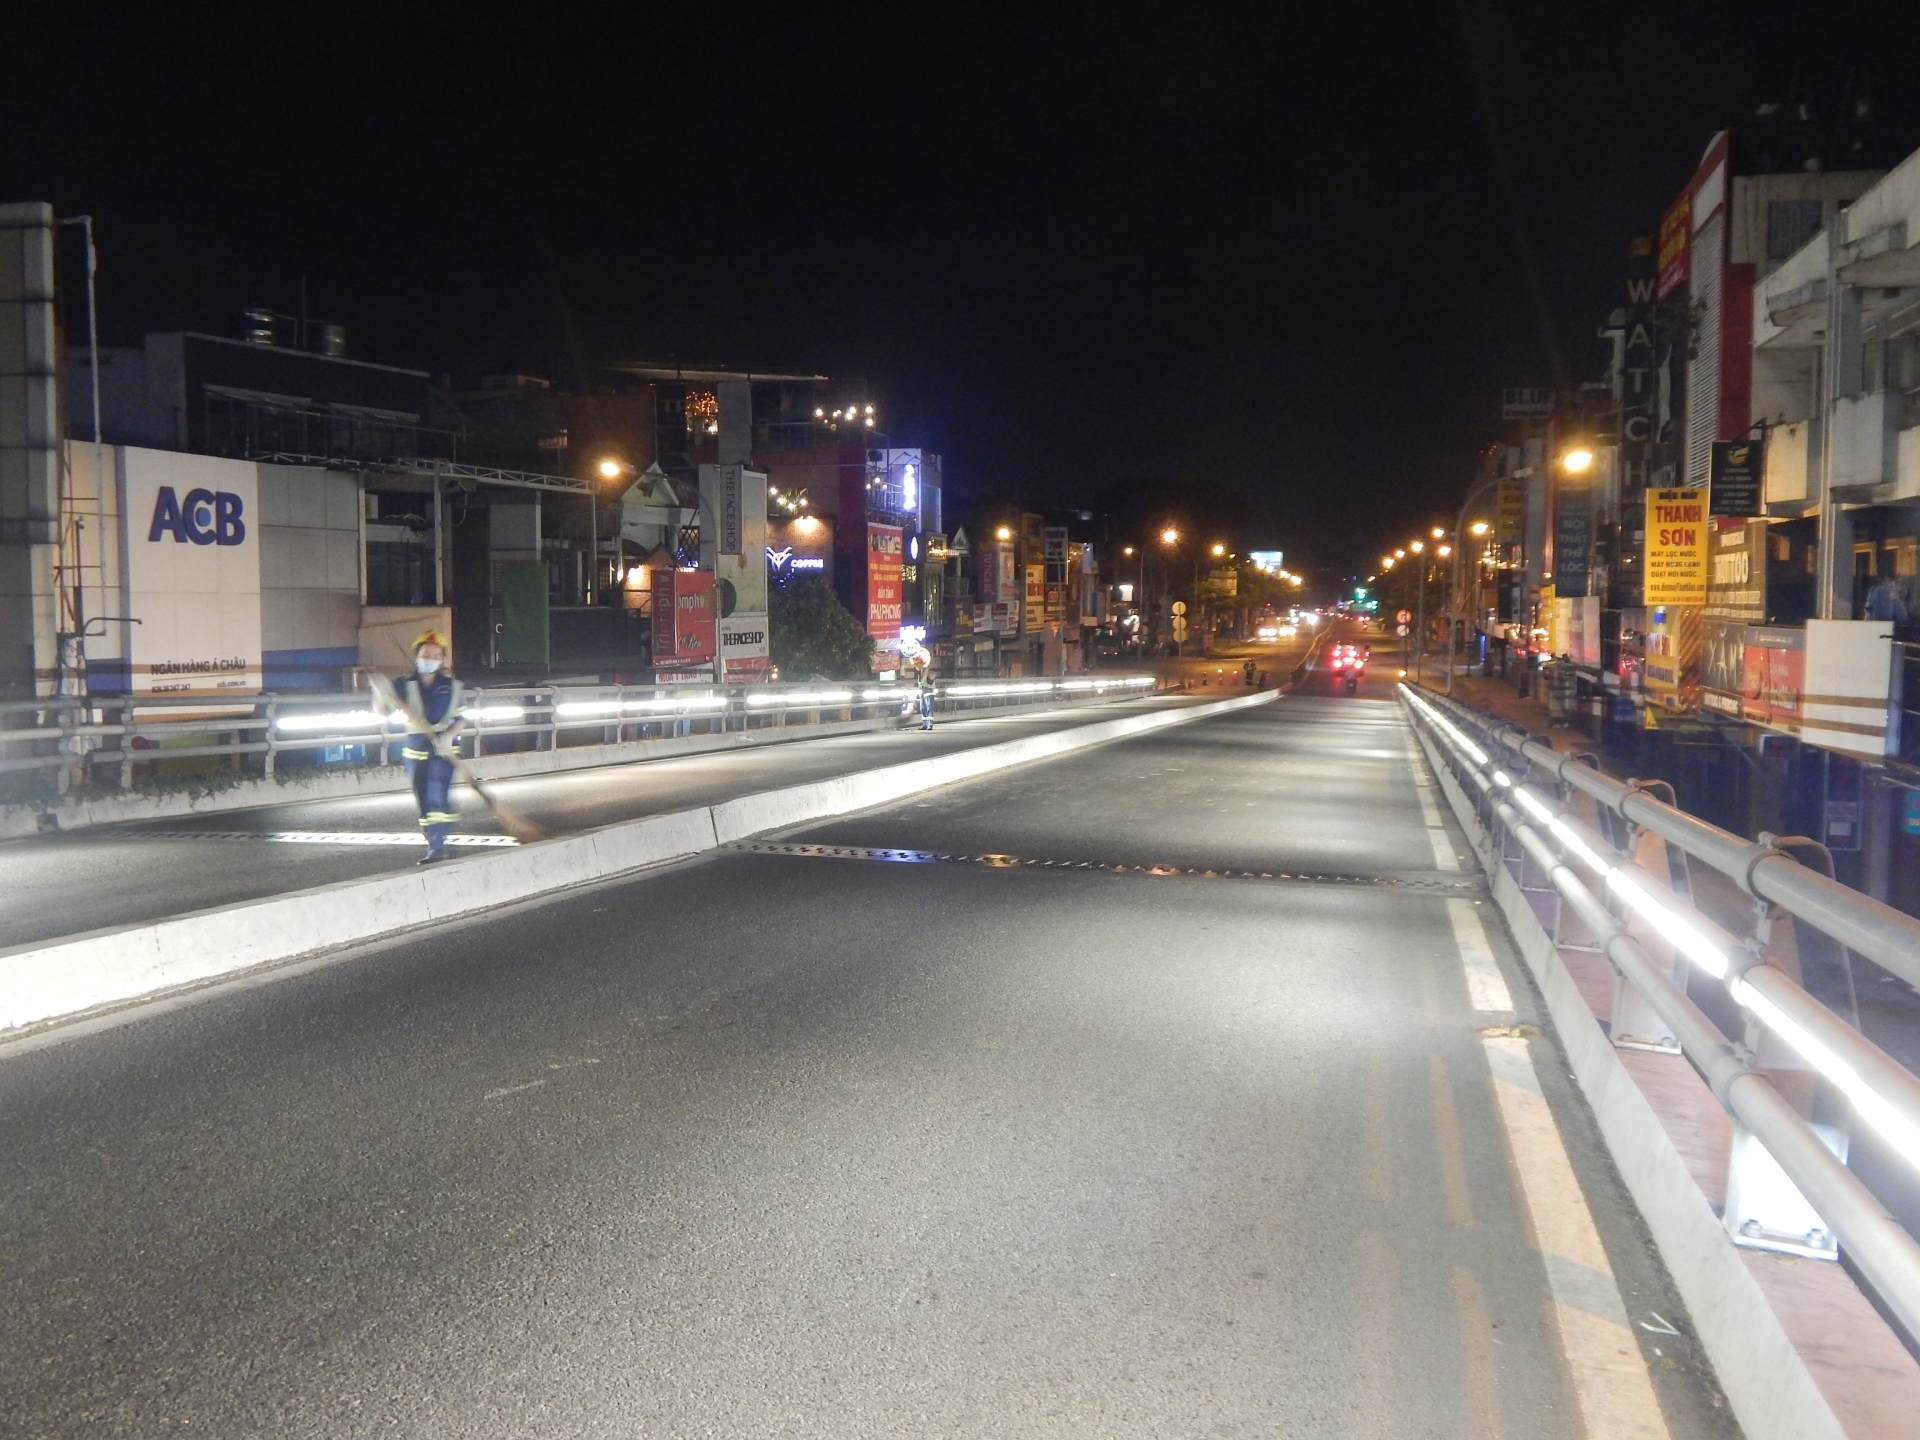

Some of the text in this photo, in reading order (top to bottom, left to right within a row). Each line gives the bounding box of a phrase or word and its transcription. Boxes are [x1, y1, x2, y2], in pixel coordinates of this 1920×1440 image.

[148, 486, 246, 546] ACB
[1655, 505, 1702, 523] THANH
[1659, 527, 1697, 547] SƠN
[151, 656, 245, 675] NGÂN HÀNG Á CHÂU
